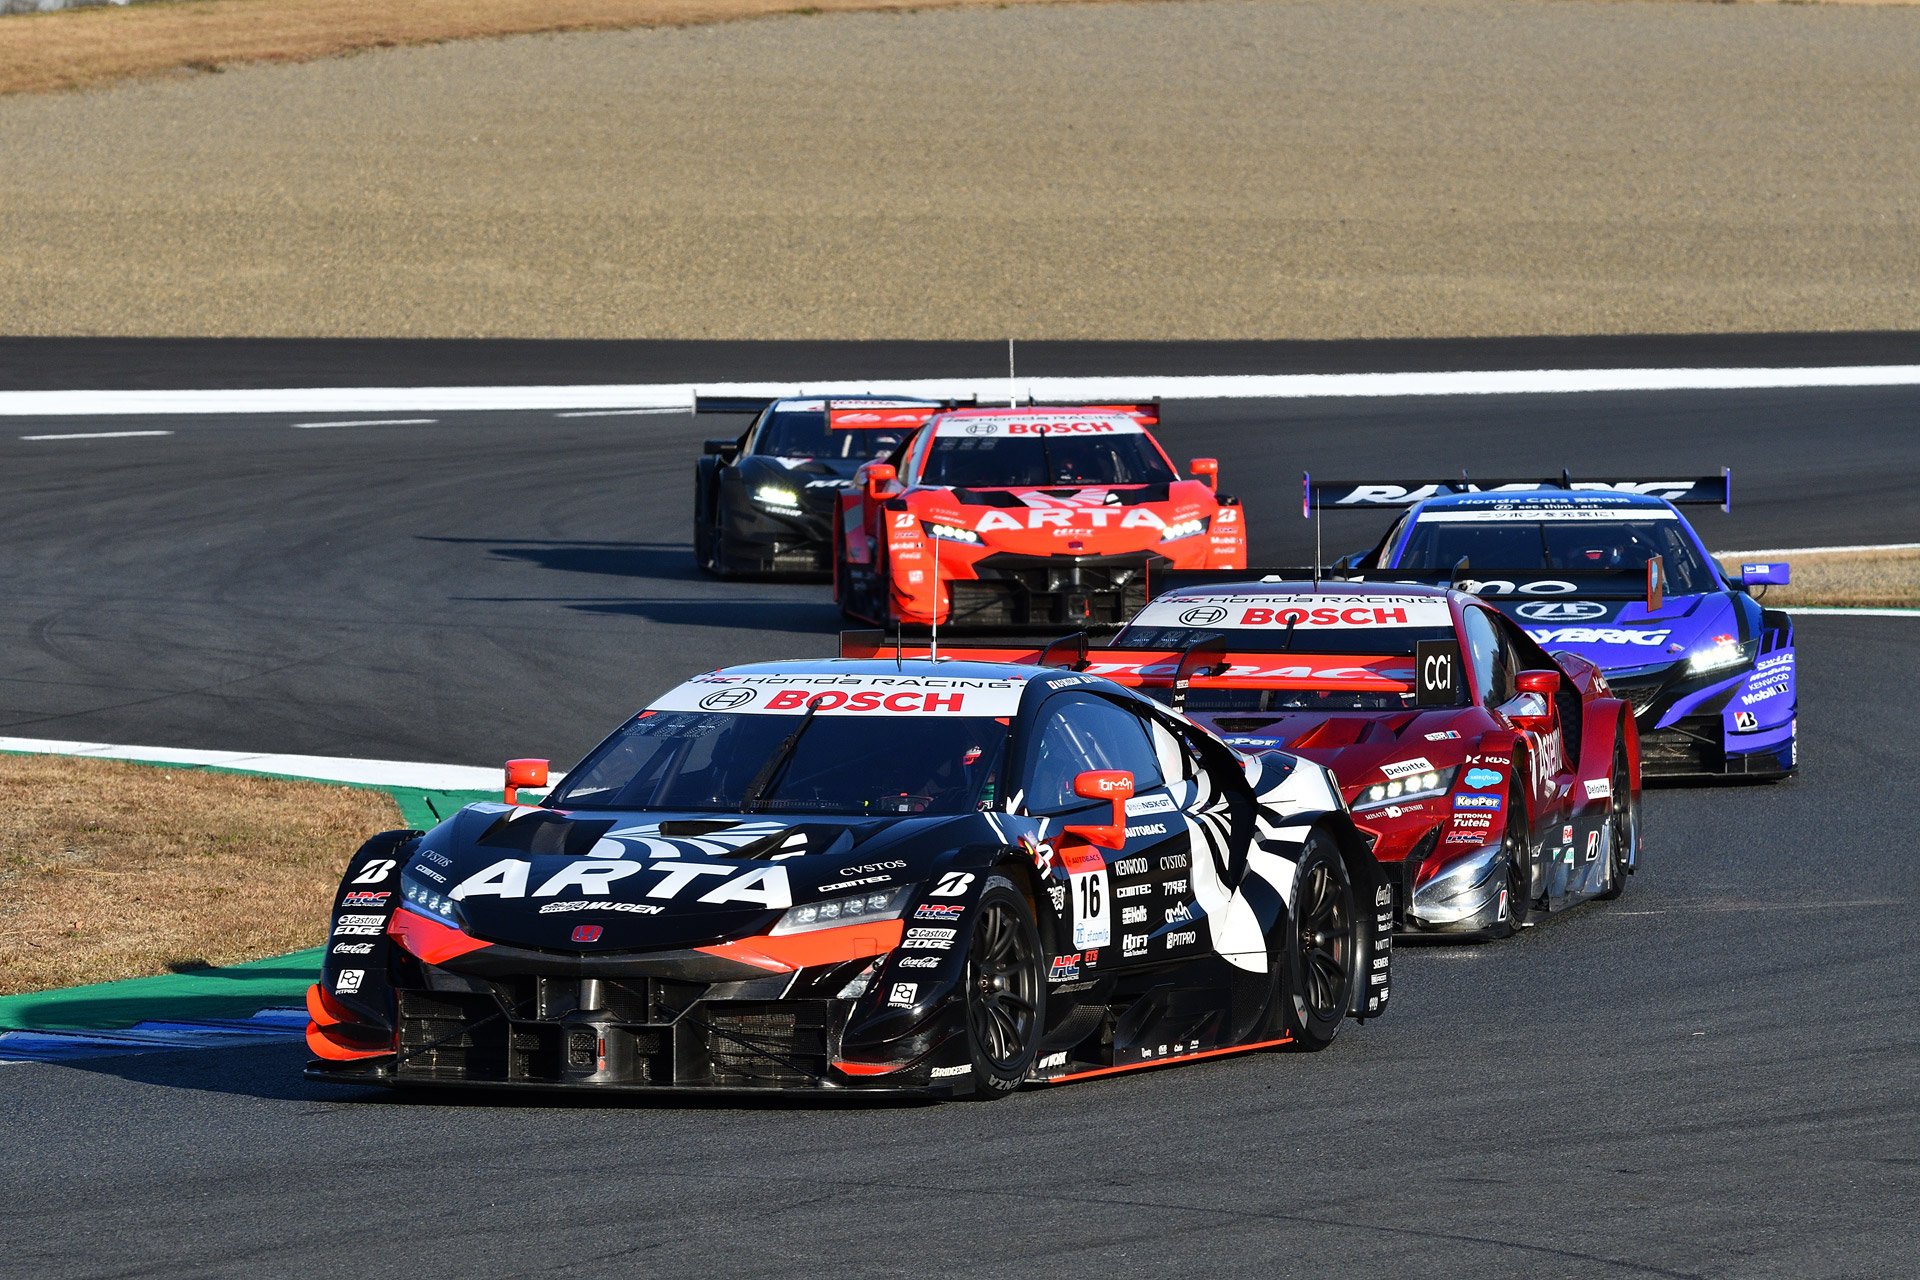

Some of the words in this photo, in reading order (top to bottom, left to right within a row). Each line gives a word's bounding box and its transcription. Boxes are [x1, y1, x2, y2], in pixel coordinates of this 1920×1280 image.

[1009, 422, 1115, 434] BOSCH
[974, 508, 1167, 532] ARTA
[1208, 595, 1314, 604] Honda
[1321, 596, 1439, 604] RACING
[1240, 607, 1408, 625] BOSCH
[1424, 654, 1451, 690] CCi
[1750, 665, 1792, 682] Modulo
[743, 676, 861, 686] Honda
[871, 678, 1013, 689] RACING
[1749, 673, 1790, 691] KENWOOD
[763, 690, 965, 712] BOSCH
[1741, 686, 1777, 705] Mobil
[1228, 738, 1280, 747] ePer
[1539, 726, 1563, 785] Astem
[1469, 774, 1499, 782] salesforce
[1141, 799, 1170, 809] NSX-GT
[1456, 796, 1499, 807] KeePer
[1365, 811, 1388, 820] MISATO
[1125, 823, 1167, 838] AUTOBACS
[1453, 819, 1491, 828] Tutela
[421, 849, 453, 867] CVSTOS
[1072, 854, 1101, 865] AUTOBACS
[1160, 853, 1187, 871] CVSTOS
[415, 864, 448, 884] COMTEC
[840, 859, 907, 876] CVSTOS
[1114, 857, 1149, 877] KENWOOD
[448, 858, 793, 910] ARTA
[817, 875, 893, 893] COMTEC
[1116, 883, 1152, 899] COMTEC
[1080, 873, 1101, 920] 16
[584, 901, 666, 915] MUGEN
[348, 915, 382, 925] Castrol
[332, 925, 385, 936] EDGE
[918, 929, 952, 938] Castrol
[901, 939, 955, 949] EDGE
[1173, 931, 1197, 947] PITPRO
[1373, 956, 1389, 970] SIEMENS
[887, 1002, 913, 1010] PITPRO
[930, 1063, 973, 1078] BRIDGESTONE
